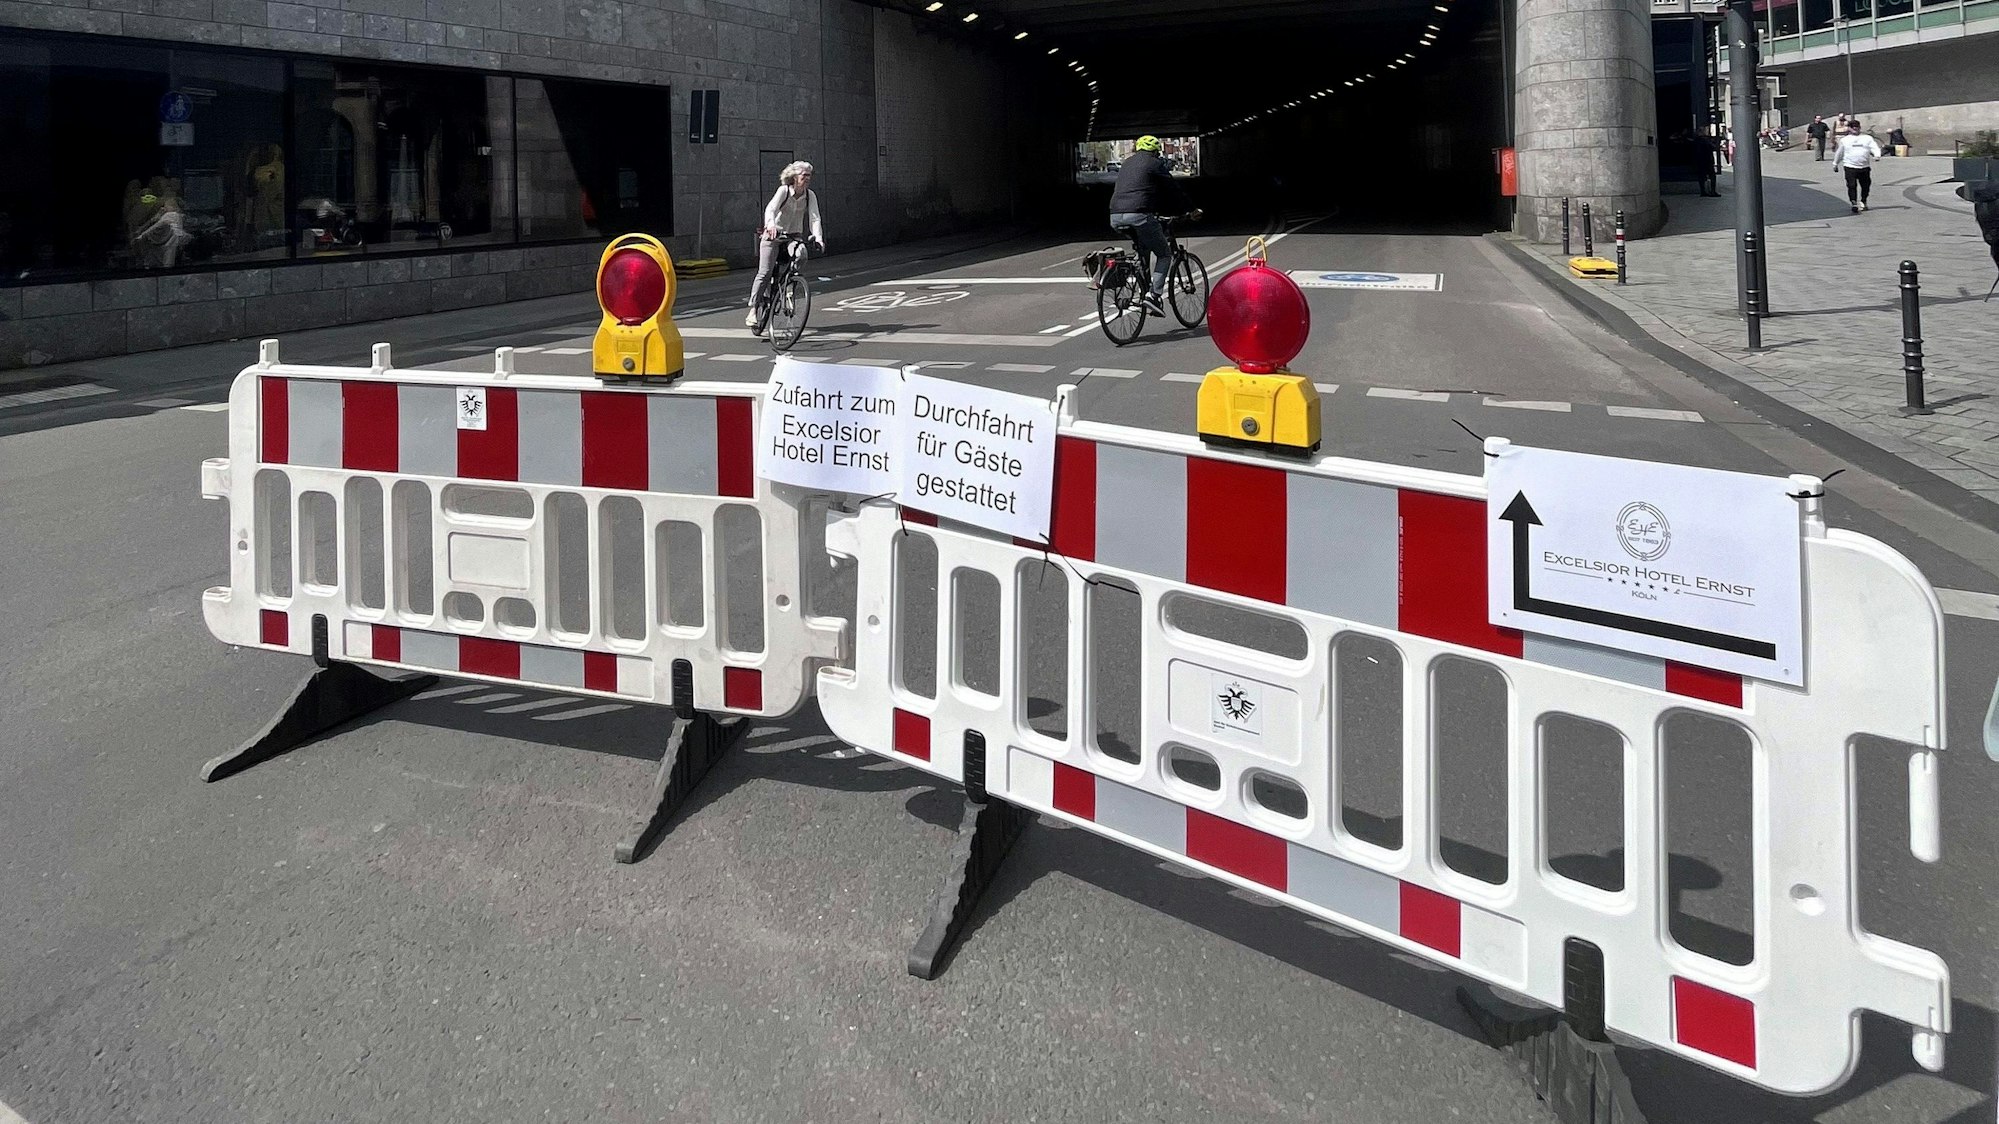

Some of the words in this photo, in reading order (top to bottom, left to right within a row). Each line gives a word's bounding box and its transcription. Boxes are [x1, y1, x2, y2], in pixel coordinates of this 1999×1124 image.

[772, 381, 843, 410] Zufahrt
[850, 395, 895, 416] zum
[914, 394, 1034, 443] Durchfahrt
[783, 413, 881, 445] Excelsior
[773, 436, 824, 464] Hotel
[833, 444, 889, 472] Ernst
[917, 431, 947, 458] für
[954, 440, 1022, 477] Gäste
[916, 472, 1016, 514] gestattet
[1544, 551, 1630, 577] EXCELSIOR
[1635, 566, 1692, 587] HOTEL
[1696, 576, 1756, 598] ERNST
